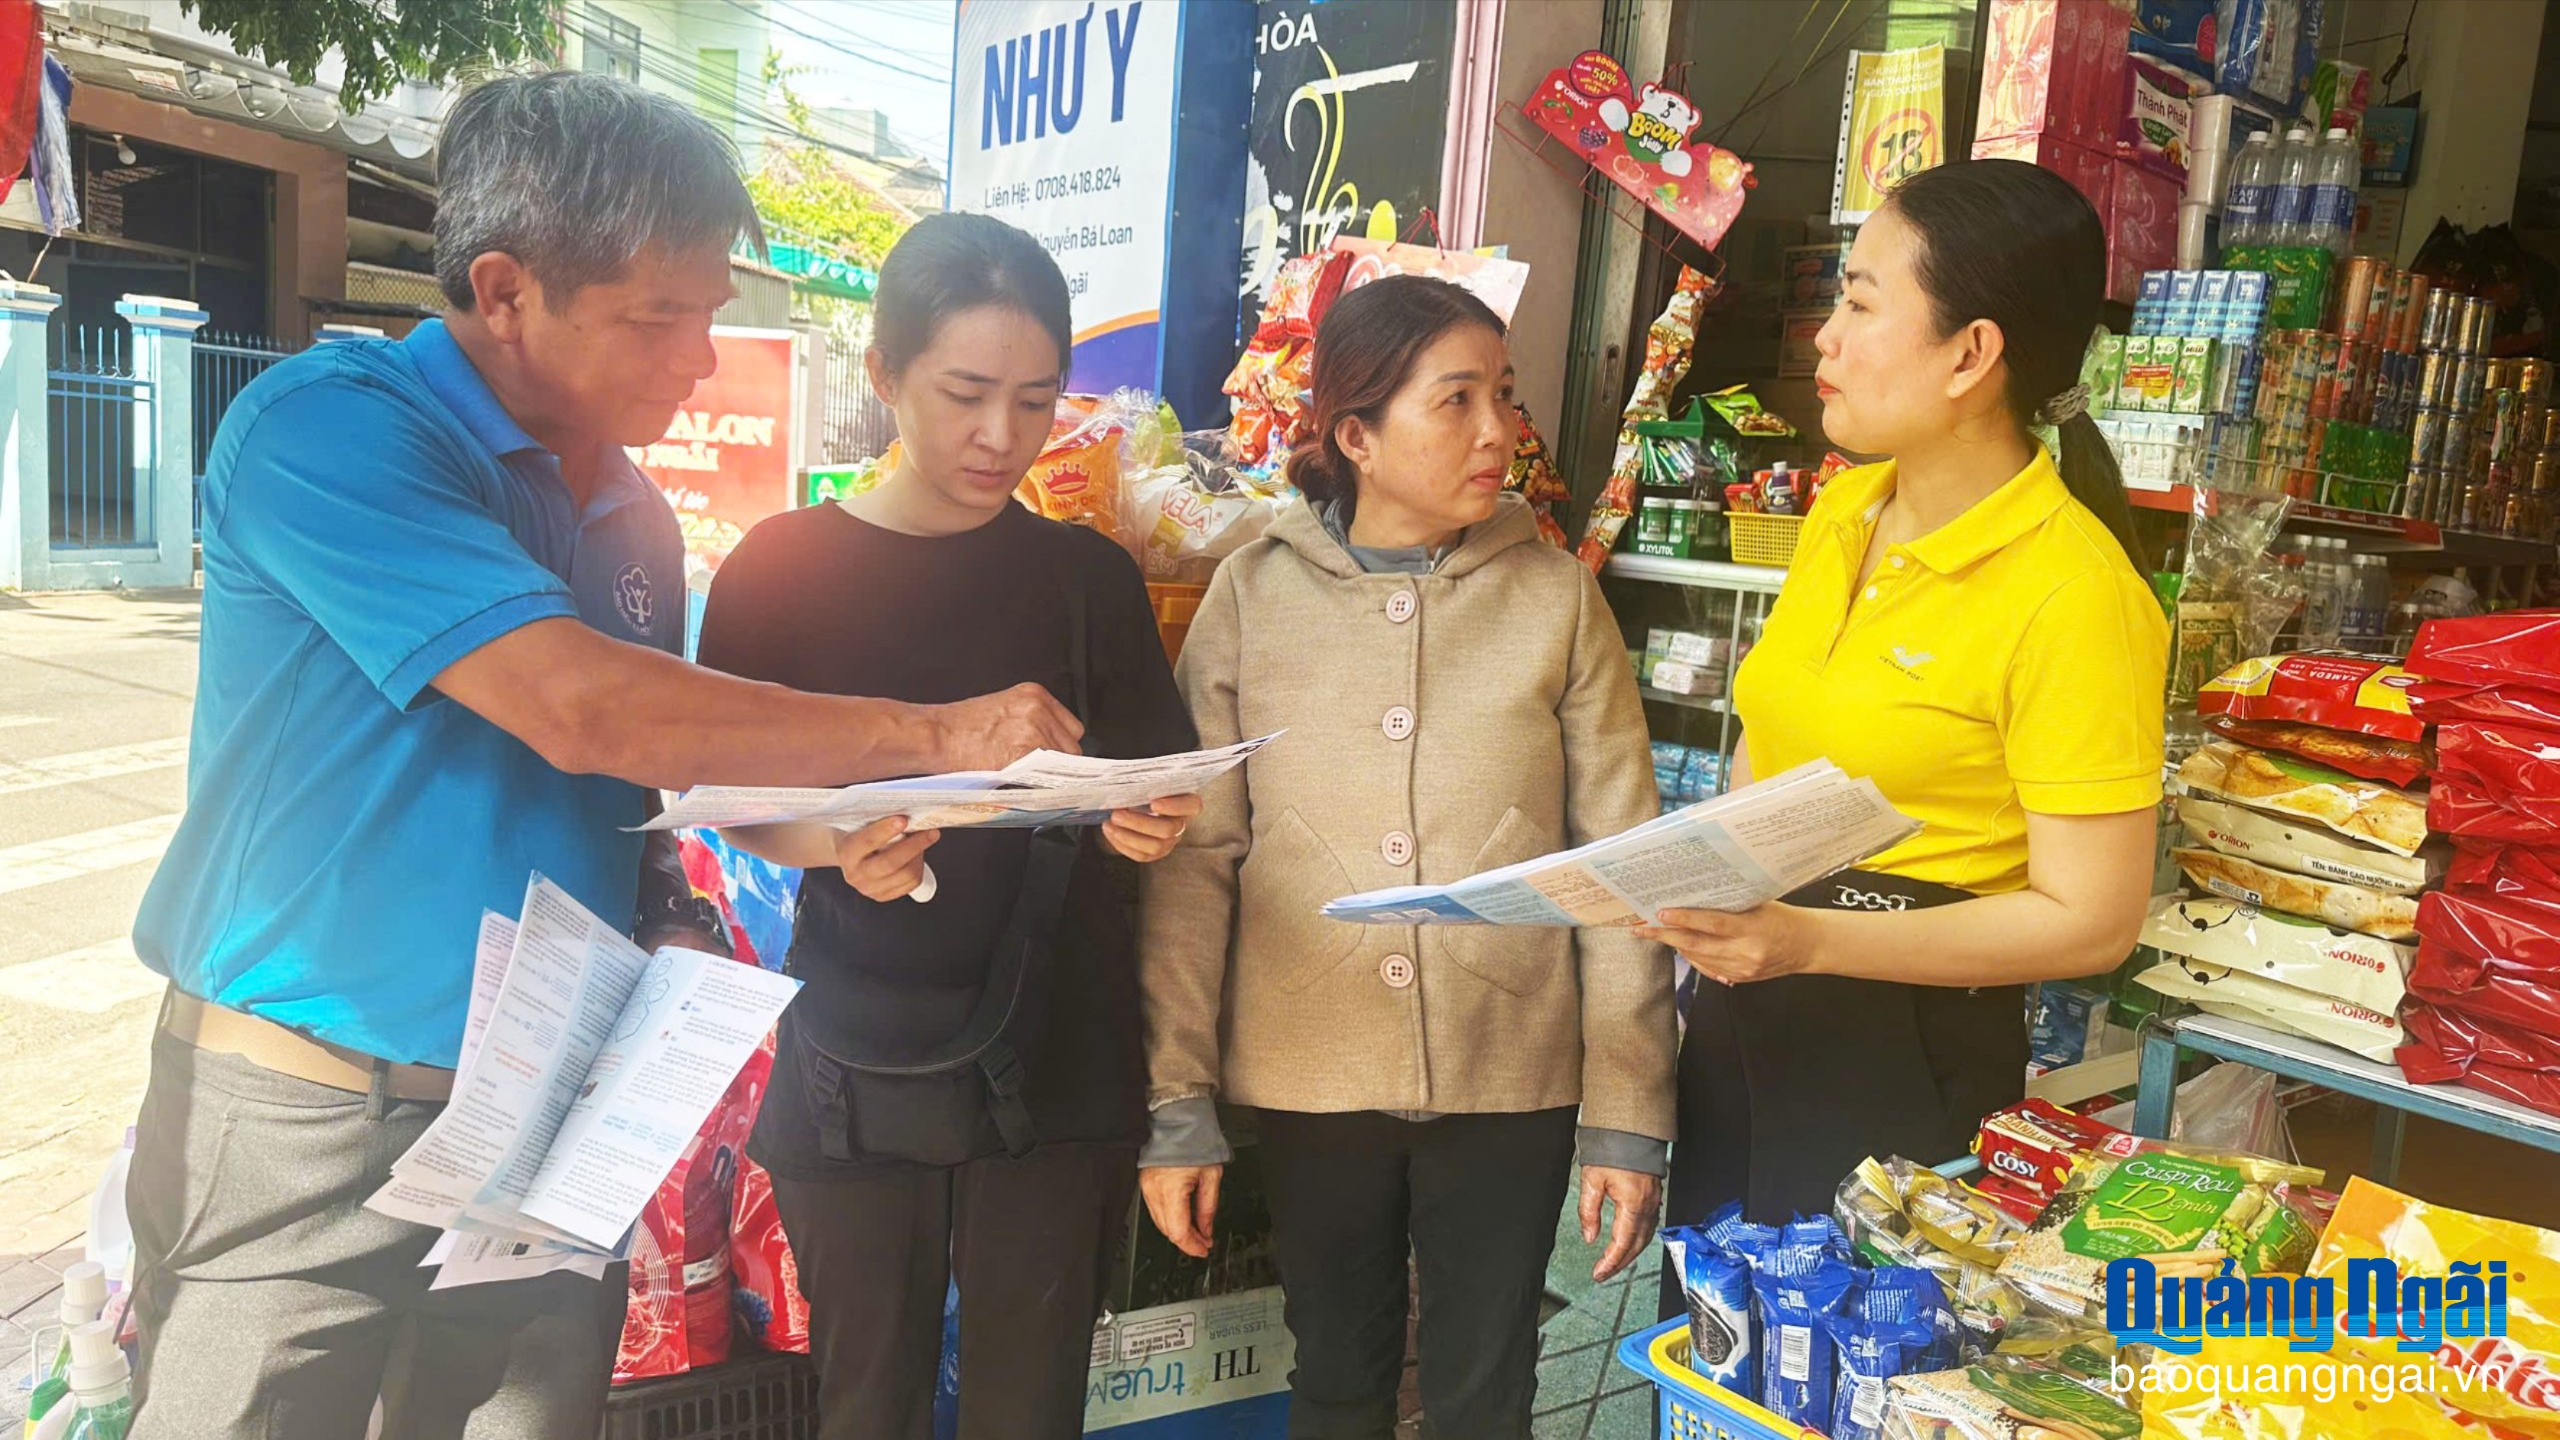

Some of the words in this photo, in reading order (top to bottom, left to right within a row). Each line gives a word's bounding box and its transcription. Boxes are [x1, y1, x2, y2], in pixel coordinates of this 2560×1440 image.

[981, 2, 1095, 151] NHƯ
[1592, 67, 1618, 86] 50%
[1563, 88, 1589, 109] ORION
[2137, 89, 2165, 117] Thành
[2167, 103, 2188, 128] Phát
[1628, 111, 1683, 151] BOOM
[1881, 129, 1923, 180] 18
[985, 186, 1009, 209] Liên
[1012, 181, 1030, 210] Hệ:
[1035, 165, 1122, 201] 0708.418.824
[1081, 225, 1097, 248] Bá
[1100, 224, 1133, 246] Loan
[1066, 271, 1089, 300] gãi
[2185, 345, 2205, 353] MILO
[663, 410, 776, 447] ALON
[1645, 544, 1675, 556] XYLITOL
[1879, 655, 1905, 672] VIETNAM
[1906, 670, 1925, 682] POST
[2309, 671, 2358, 682] KAMEDA
[2219, 833, 2250, 851] ORION
[2311, 861, 2326, 871] TÊN:
[2328, 865, 2349, 876] BÁNH
[2328, 949, 2375, 969] ORION
[2330, 1001, 2381, 1024] ORION
[1993, 1150, 2039, 1179] COSY
[2105, 1180, 2177, 1222] 12
[1208, 1324, 1242, 1341] SUGAR
[1243, 1320, 1267, 1333] LESS
[1212, 1345, 1262, 1383] TH
